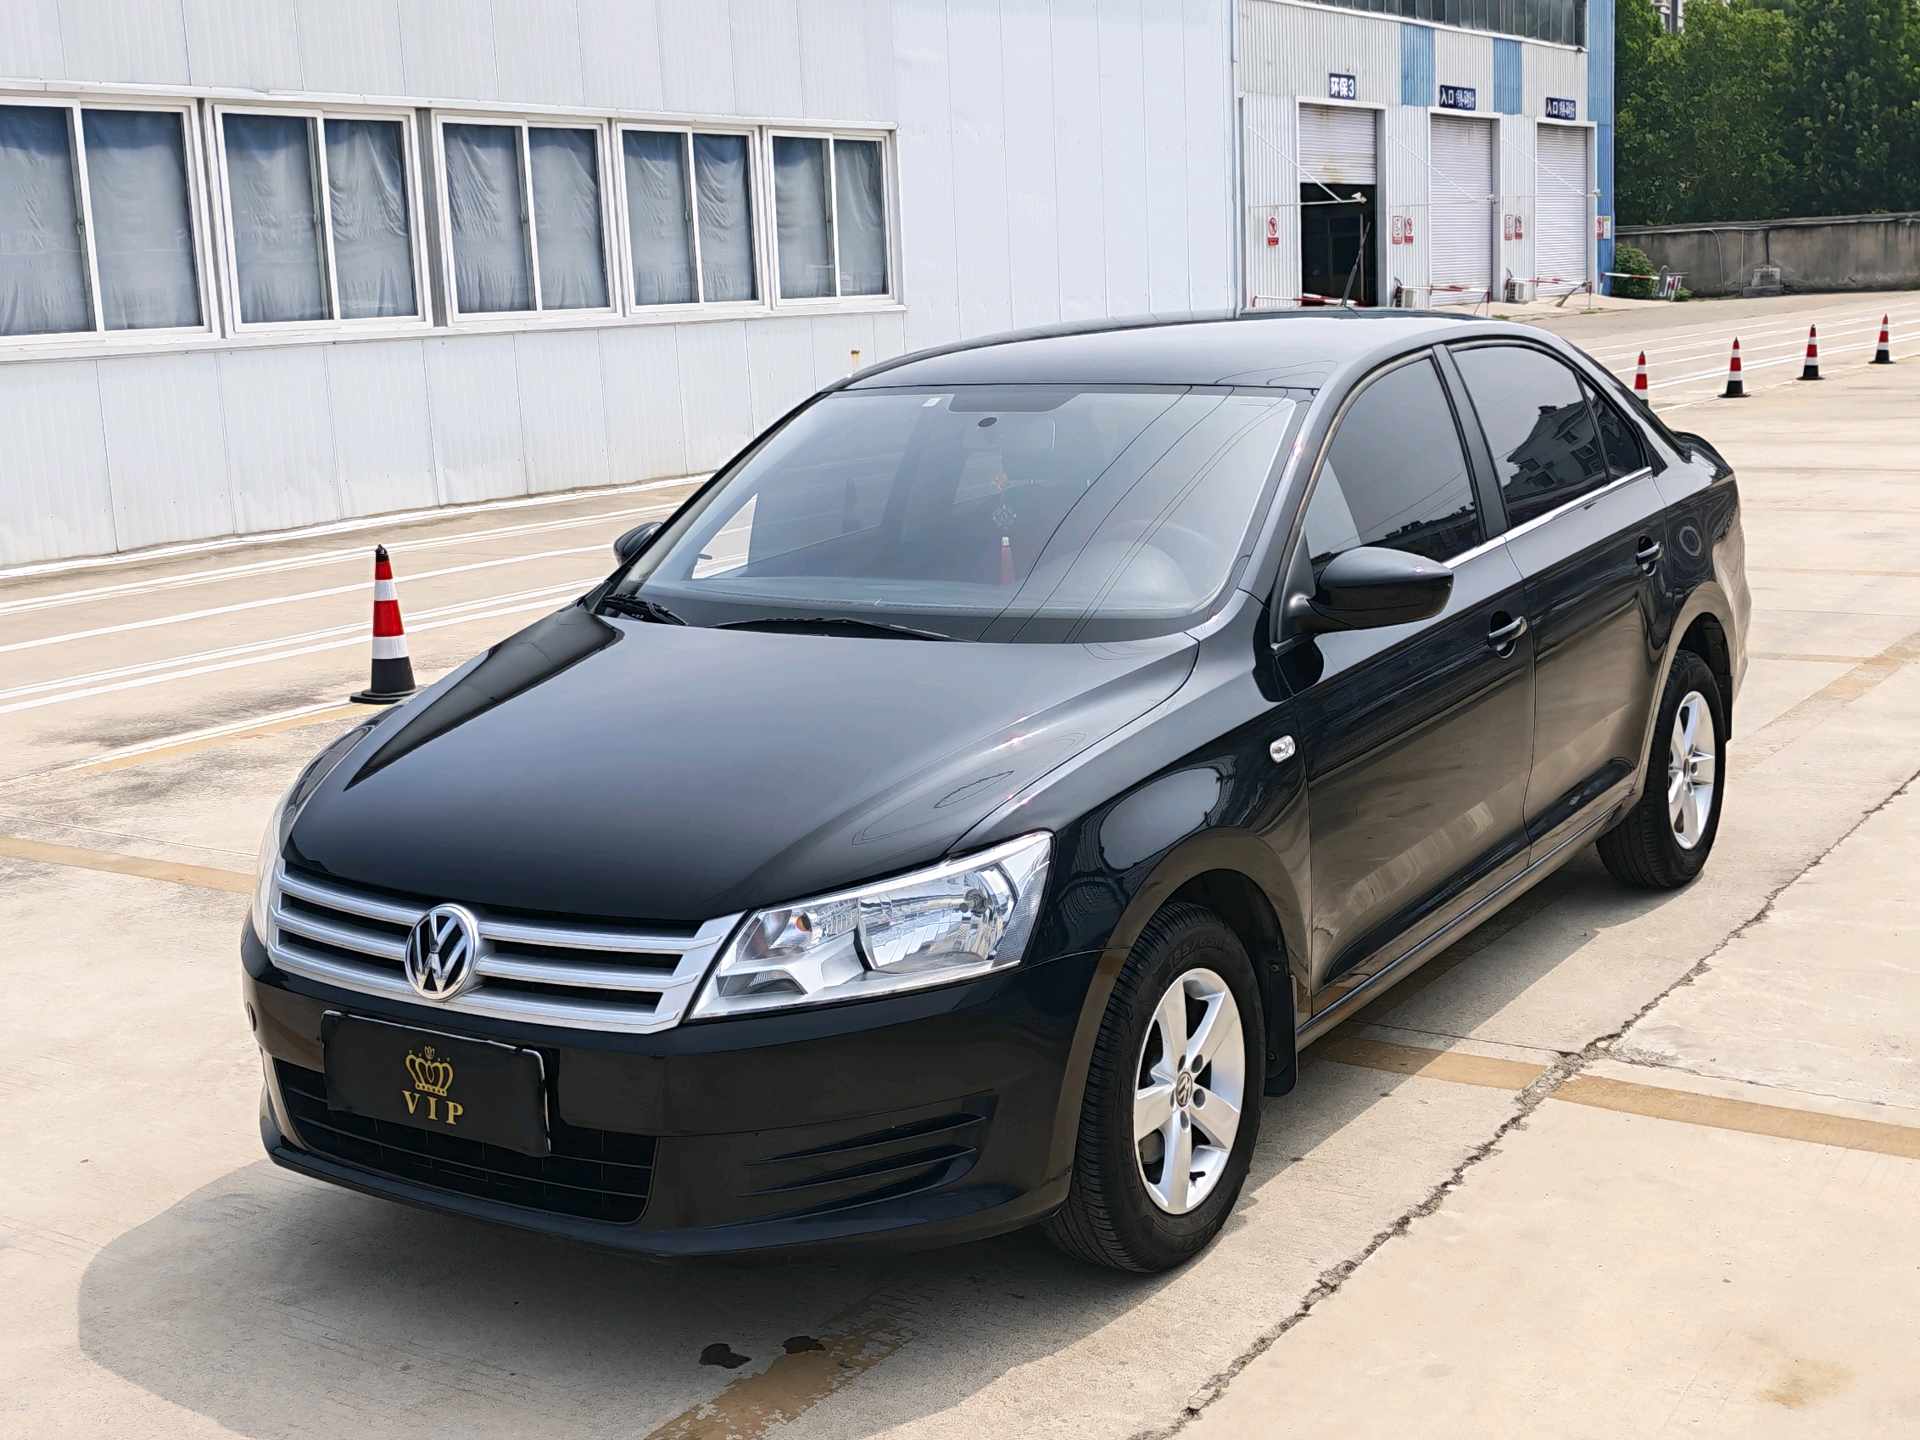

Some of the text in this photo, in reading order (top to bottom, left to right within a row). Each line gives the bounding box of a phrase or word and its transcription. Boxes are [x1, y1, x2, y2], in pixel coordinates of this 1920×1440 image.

[1330, 76, 1355, 97] 环保3
[1440, 87, 1455, 105] 入口
[402, 1089, 464, 1126] VIP
